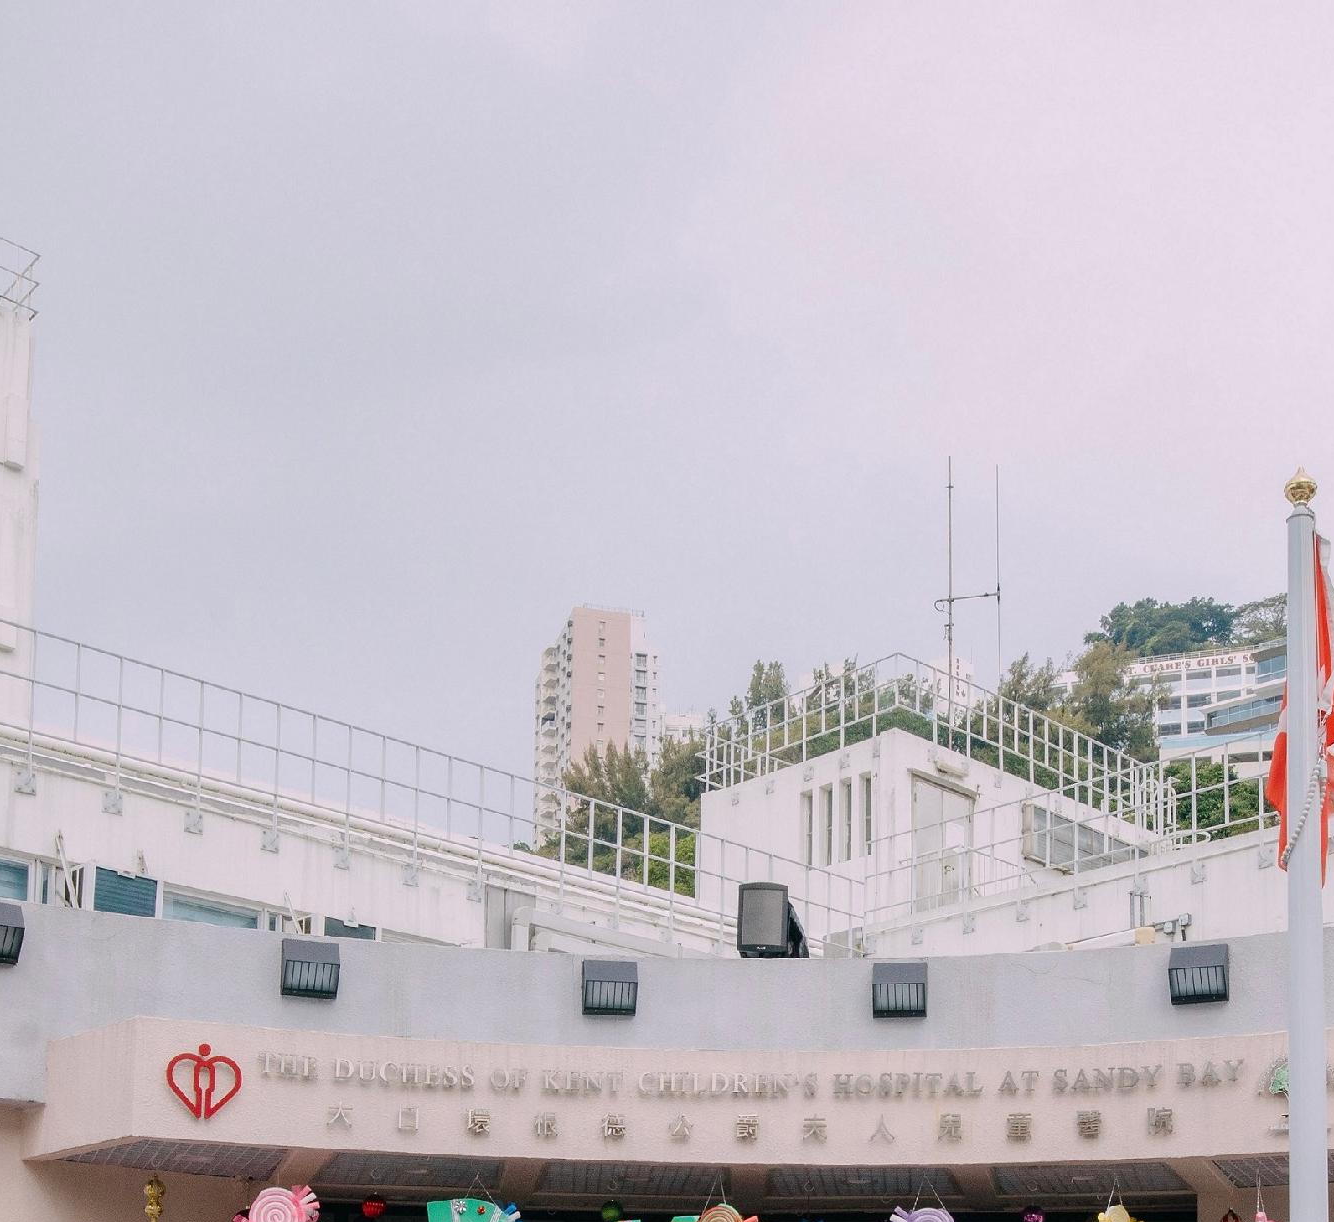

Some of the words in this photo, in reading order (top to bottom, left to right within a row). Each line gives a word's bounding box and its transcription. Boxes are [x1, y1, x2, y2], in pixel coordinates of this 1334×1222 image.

[258, 1051, 317, 1080] THE
[334, 1057, 476, 1089] DUCHESS
[490, 1068, 531, 1091] OF
[541, 1068, 624, 1093] KENT
[637, 1071, 820, 1097] CHILDREN'S
[833, 1071, 984, 1097] HOSPITAL
[998, 1070, 1040, 1093] AT
[1052, 1064, 1164, 1092] SANDY
[1176, 1058, 1245, 1087] BAY
